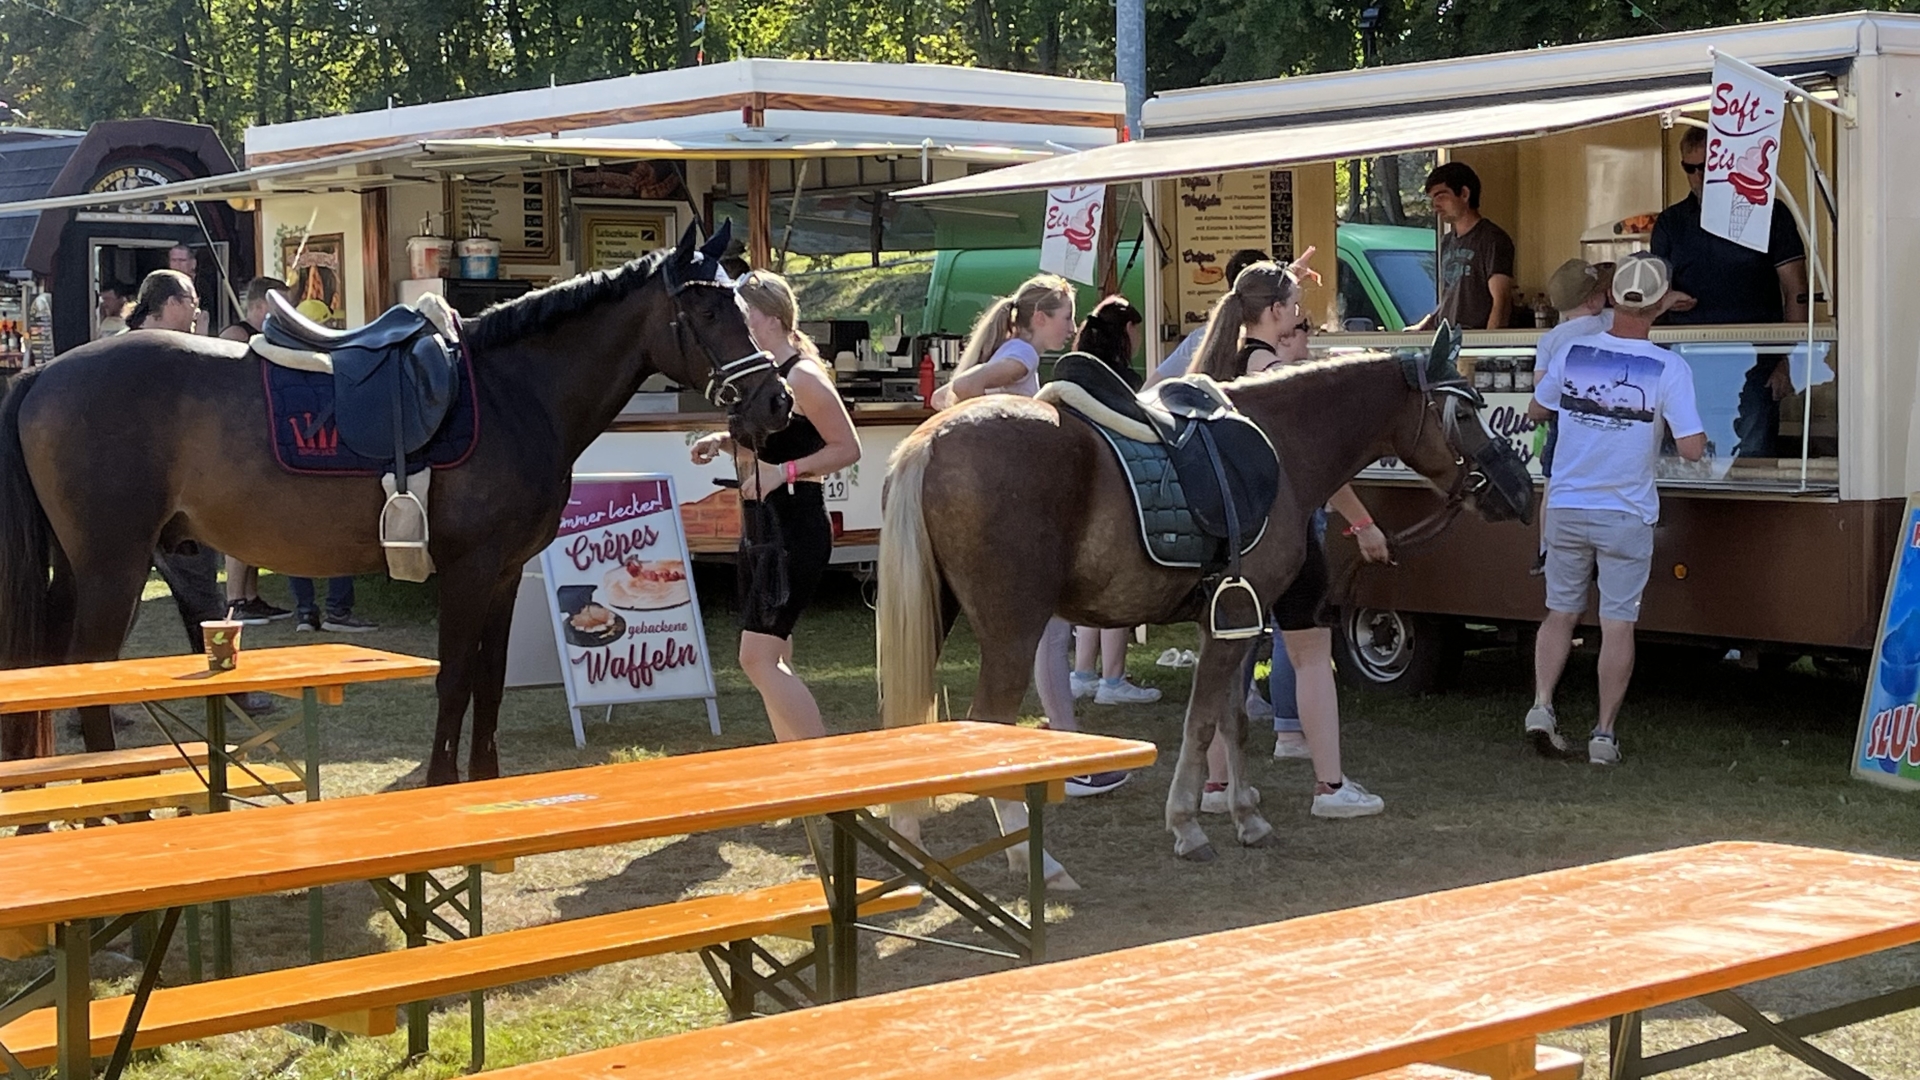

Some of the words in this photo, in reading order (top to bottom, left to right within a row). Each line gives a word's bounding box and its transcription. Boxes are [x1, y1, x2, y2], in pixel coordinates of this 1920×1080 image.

[1707, 138, 1735, 172] Eis
[1046, 205, 1070, 230] Eis
[608, 480, 665, 520] lecker!
[828, 482, 844, 498] 19
[565, 525, 660, 571] Crêpes
[627, 619, 688, 640] gebackene
[571, 637, 698, 689] Waffeln
